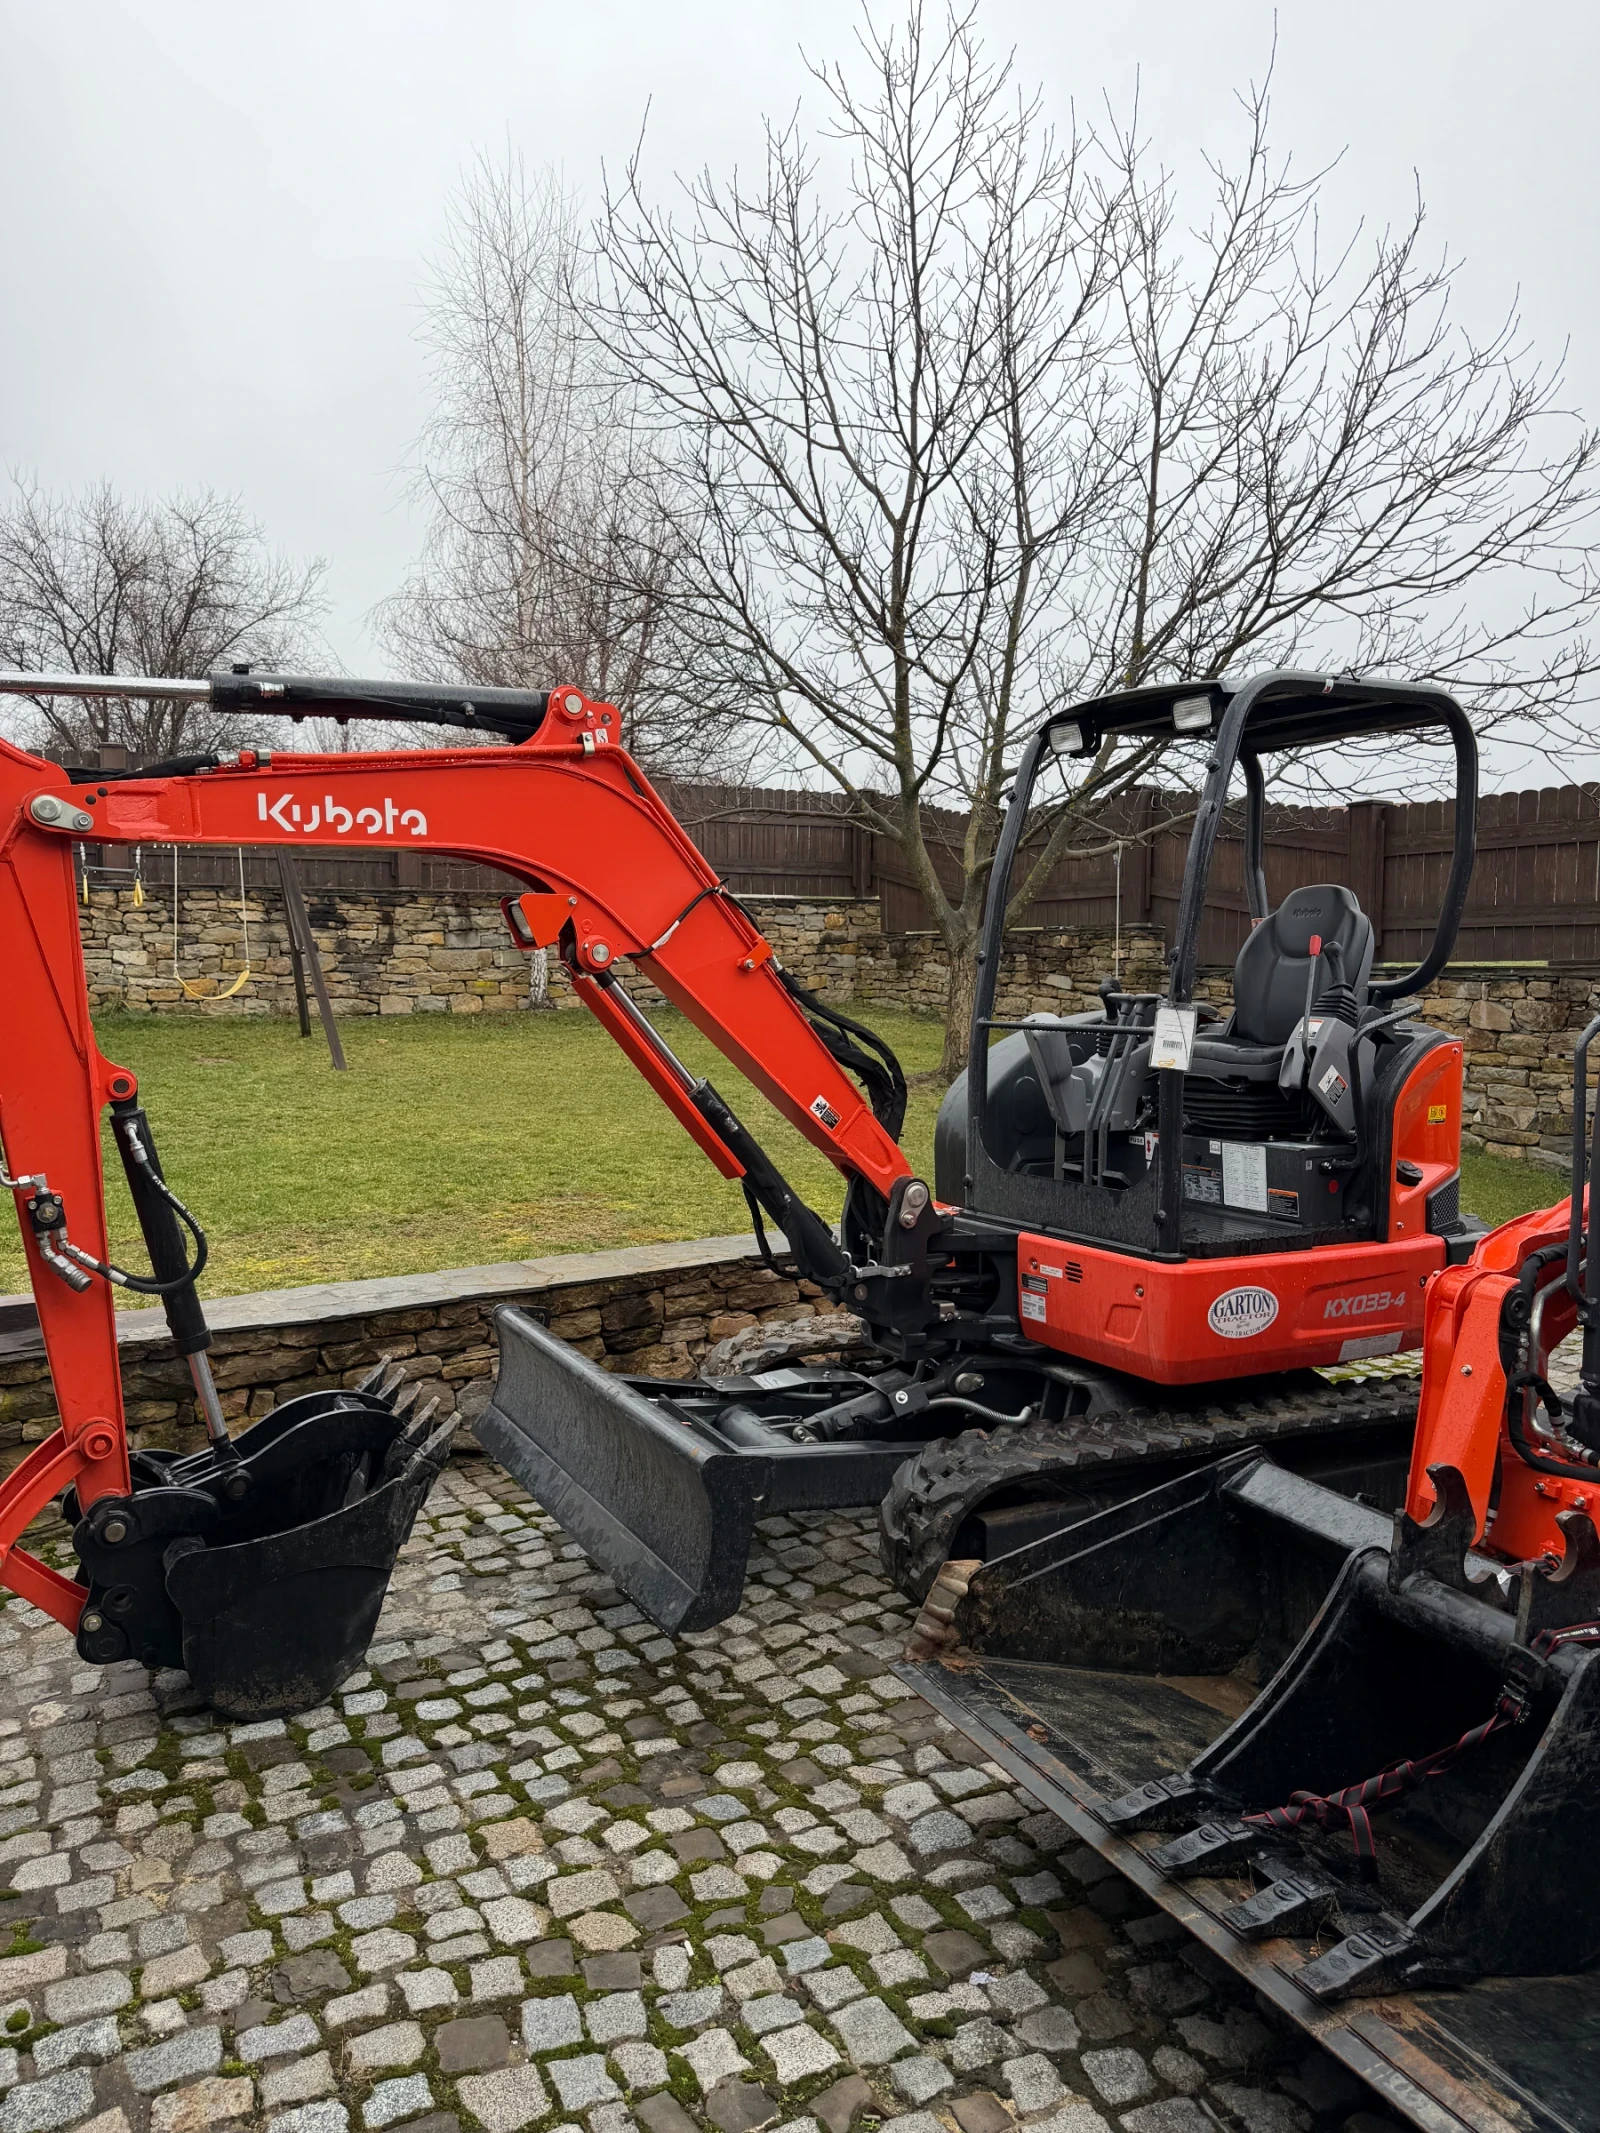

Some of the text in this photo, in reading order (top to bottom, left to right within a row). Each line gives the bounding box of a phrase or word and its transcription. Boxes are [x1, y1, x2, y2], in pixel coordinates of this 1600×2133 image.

[257, 793, 427, 836] Kubota
[1214, 1293, 1271, 1318] GARTON
[1215, 1312, 1271, 1324] TRACTOR
[1323, 1291, 1406, 1319] KX033-4
